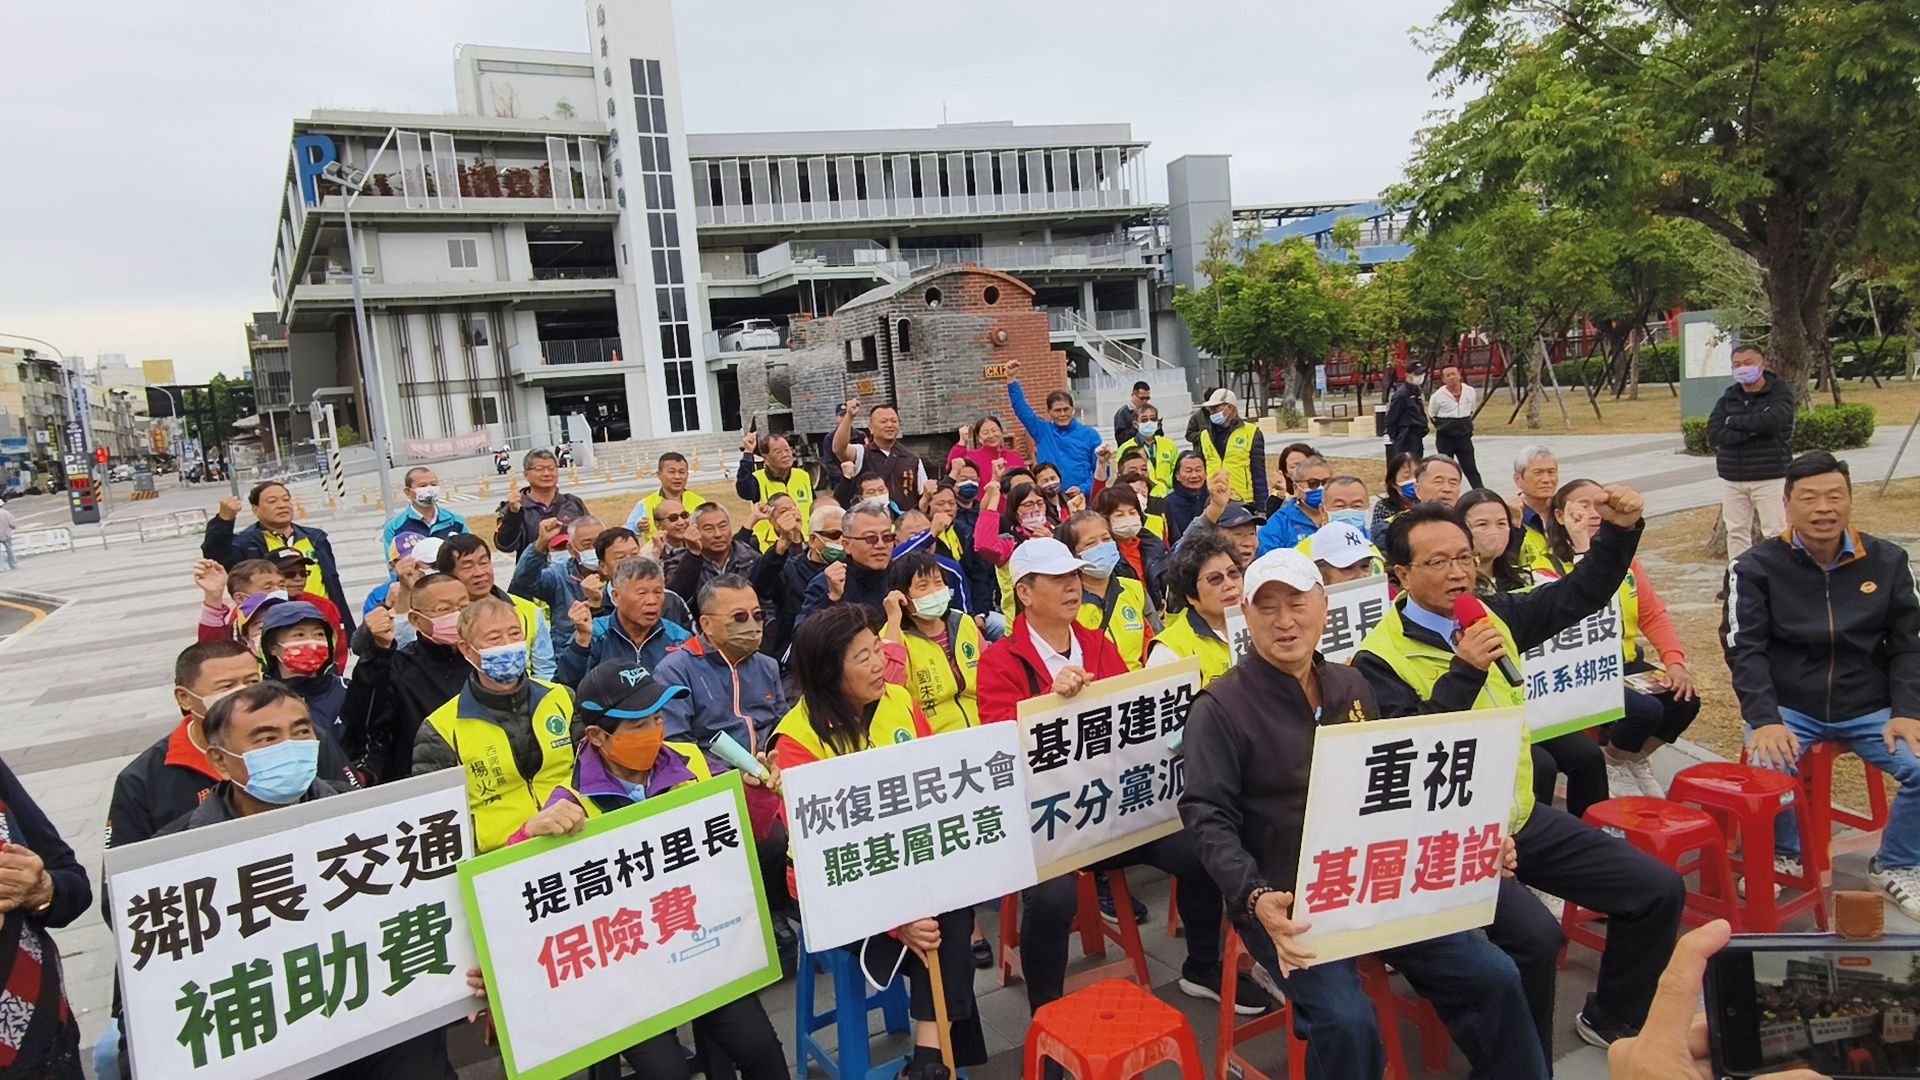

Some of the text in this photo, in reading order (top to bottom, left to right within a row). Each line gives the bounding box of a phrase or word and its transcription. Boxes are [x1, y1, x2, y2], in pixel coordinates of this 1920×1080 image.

[295, 134, 340, 207] P
[1028, 683, 1194, 775] 基層建設
[795, 750, 1017, 839] 恢復里民大會
[1358, 738, 1478, 817] 重視
[127, 809, 467, 972] 鄰長交通
[522, 813, 740, 924] 提高村里長
[823, 805, 1007, 888] 聽基層民意
[1305, 822, 1502, 914] 基層建設
[537, 884, 703, 989] 保險費
[174, 900, 457, 1069] 補助費
